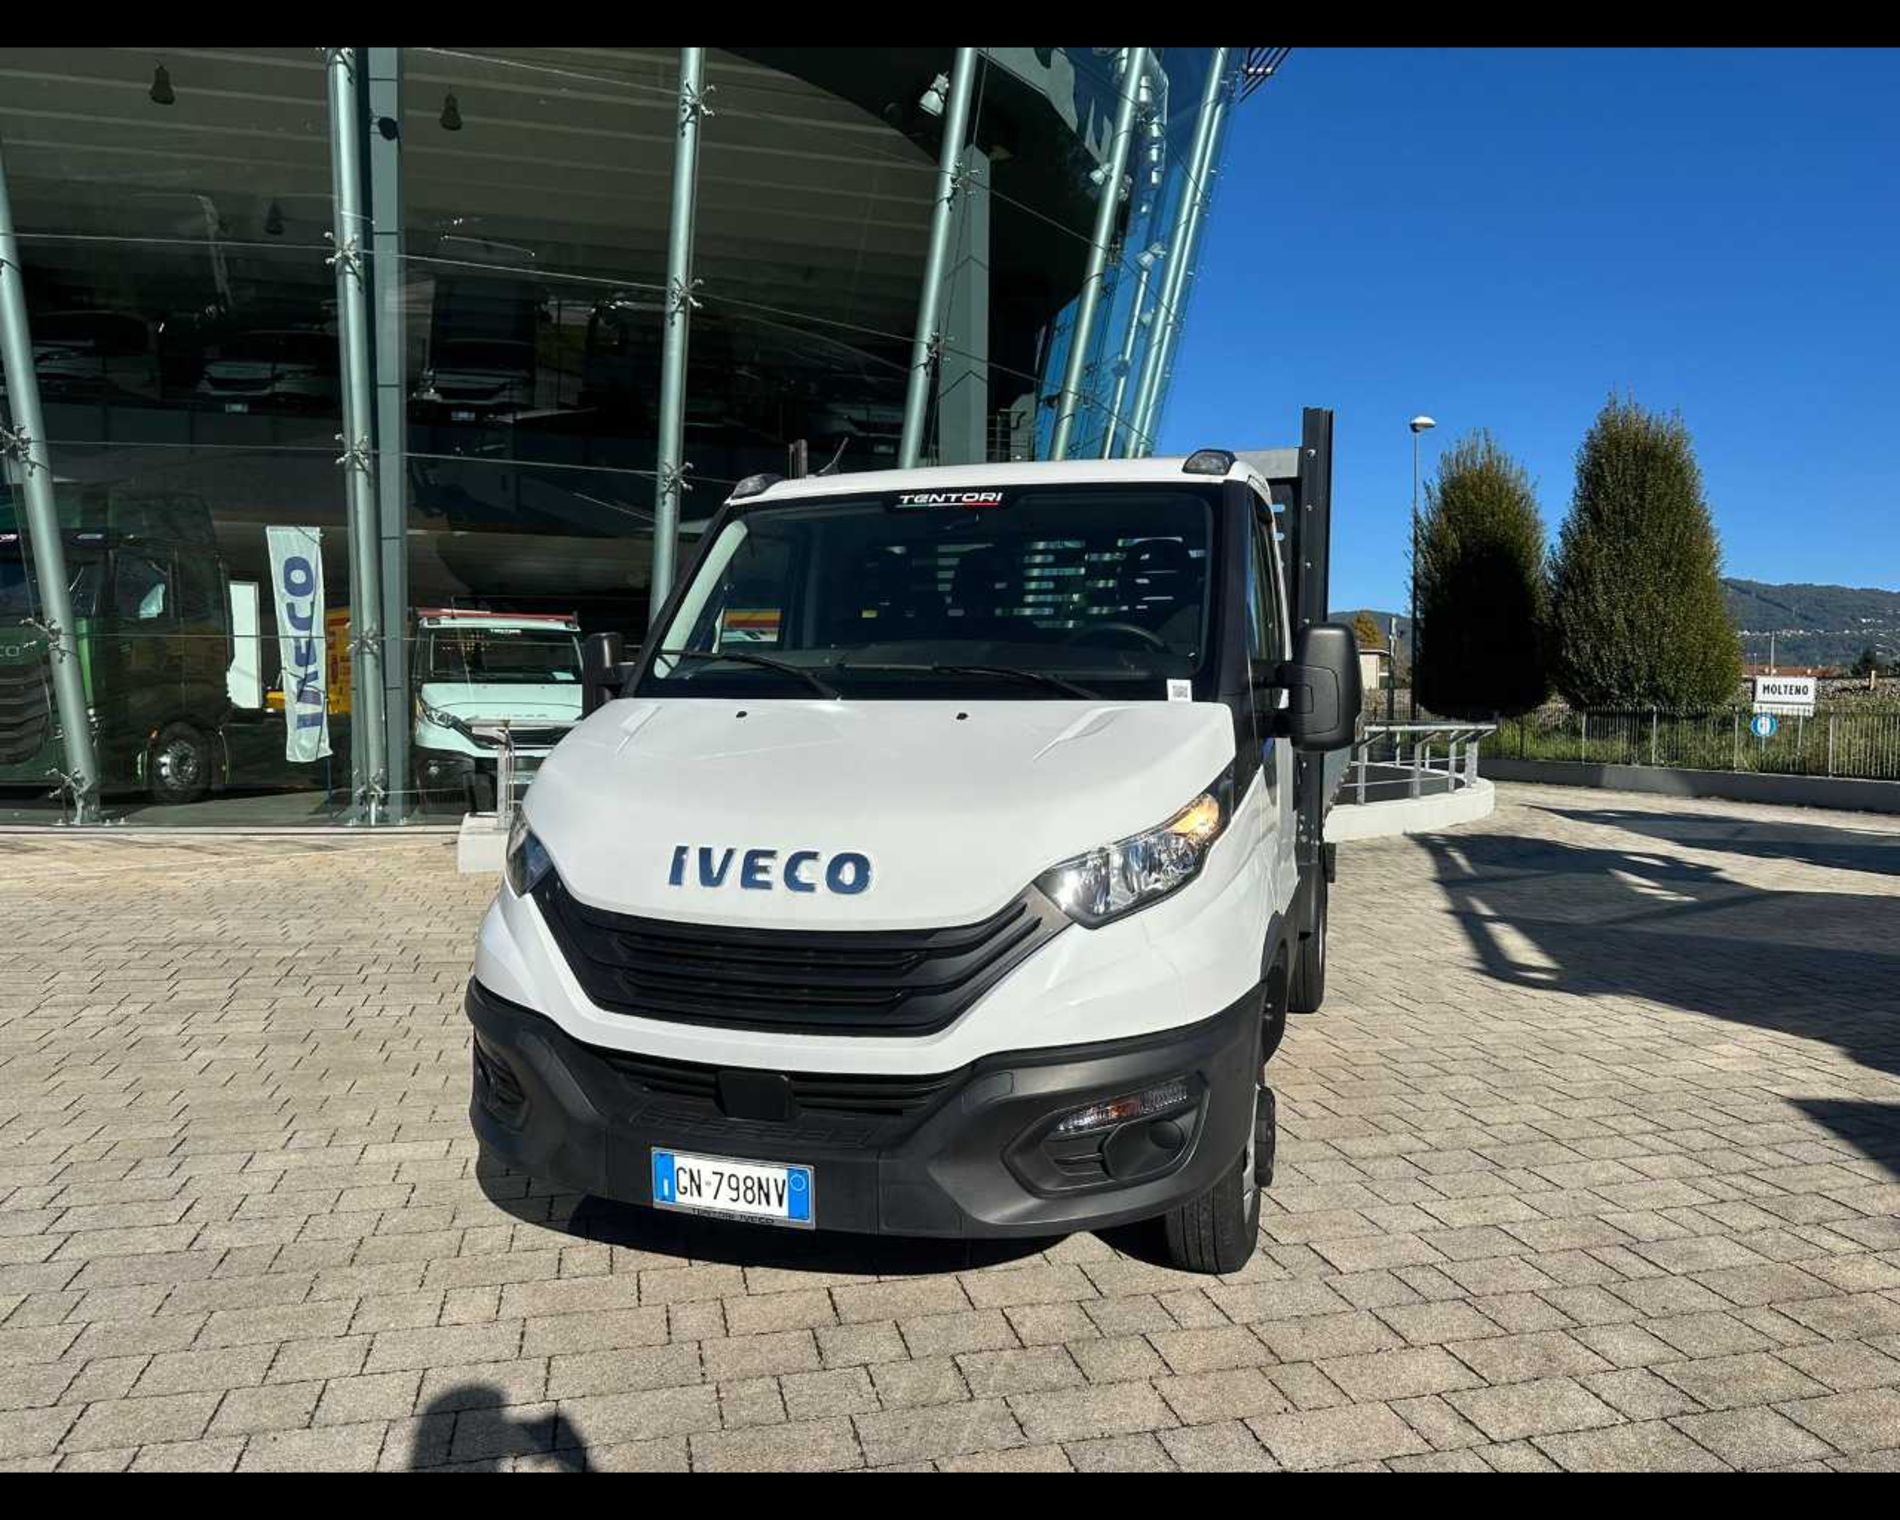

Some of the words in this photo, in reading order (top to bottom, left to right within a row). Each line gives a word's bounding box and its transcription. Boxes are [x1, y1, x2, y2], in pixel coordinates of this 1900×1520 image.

[899, 492, 1003, 503] TENTORI
[284, 556, 324, 730] IVECO
[1762, 684, 1809, 696] MOLTENO
[669, 846, 871, 895] IVECO
